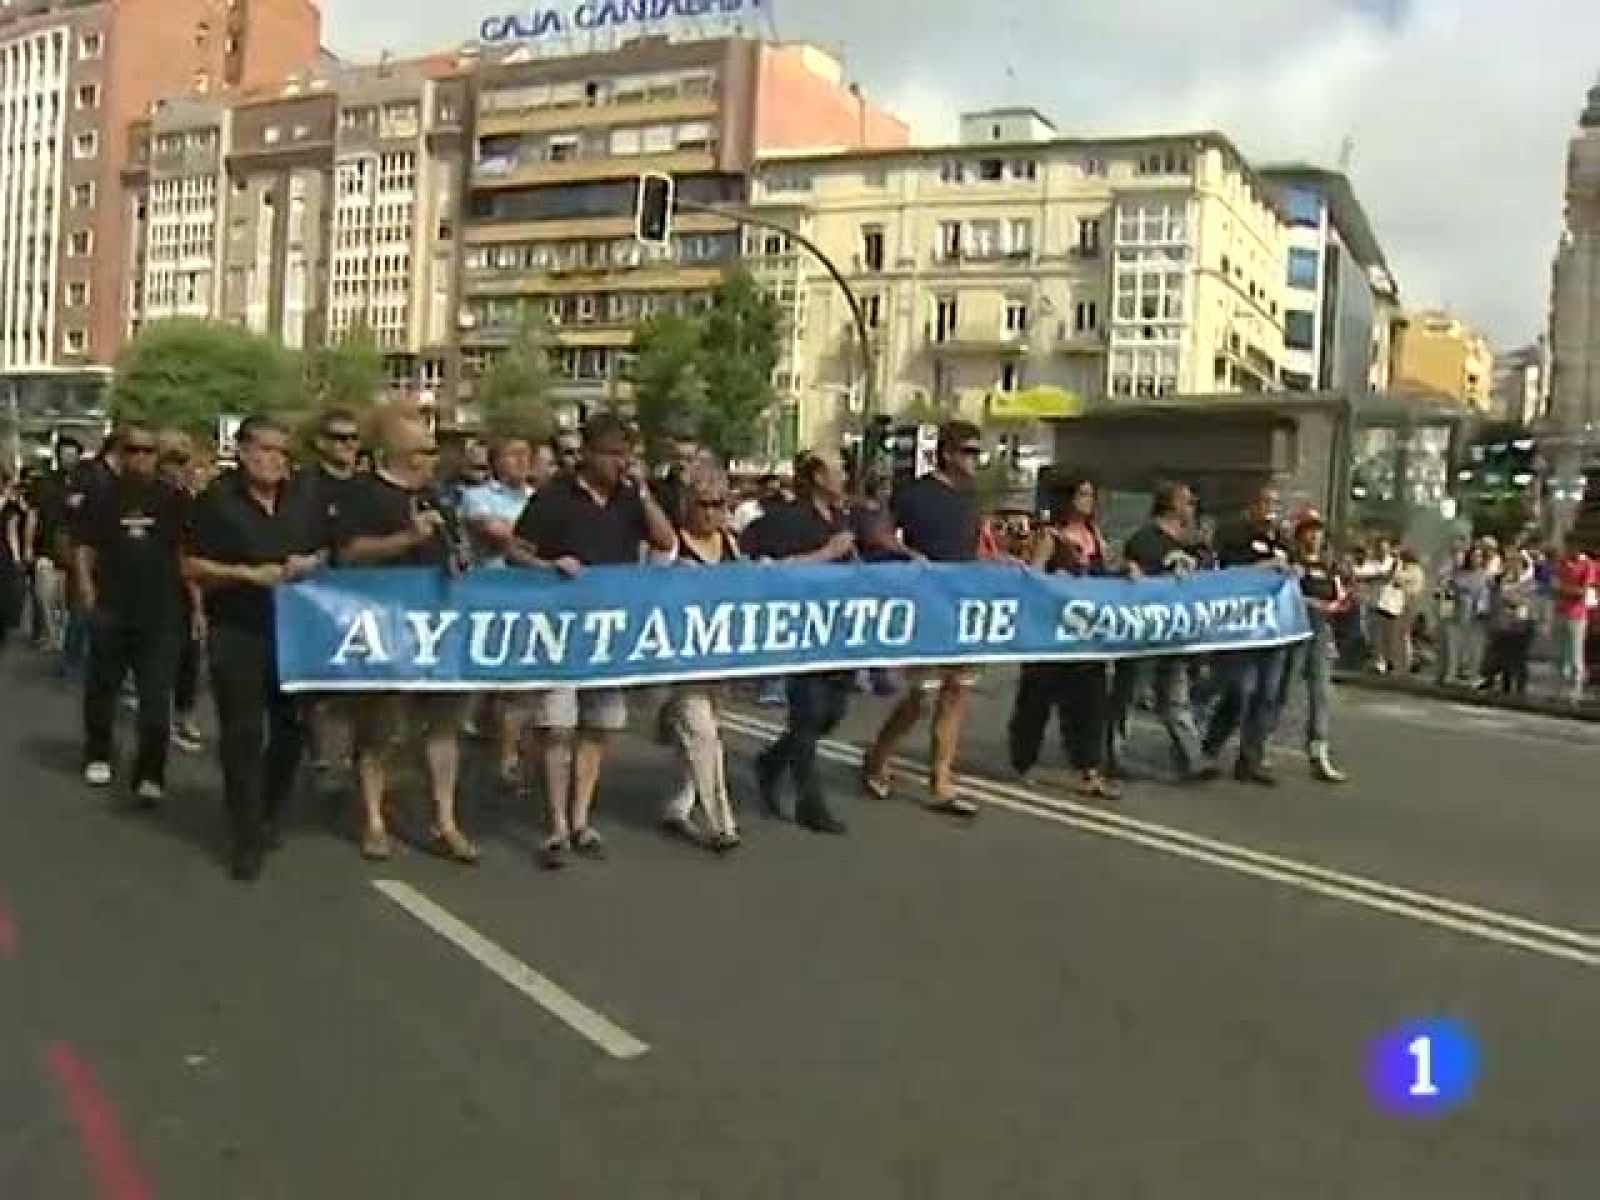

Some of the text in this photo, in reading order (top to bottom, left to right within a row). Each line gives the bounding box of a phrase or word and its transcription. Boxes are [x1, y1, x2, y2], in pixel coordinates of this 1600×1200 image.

[480, 10, 561, 40] CAJA
[328, 597, 917, 666] AYUNTAMIENTO
[959, 597, 1020, 645] DE
